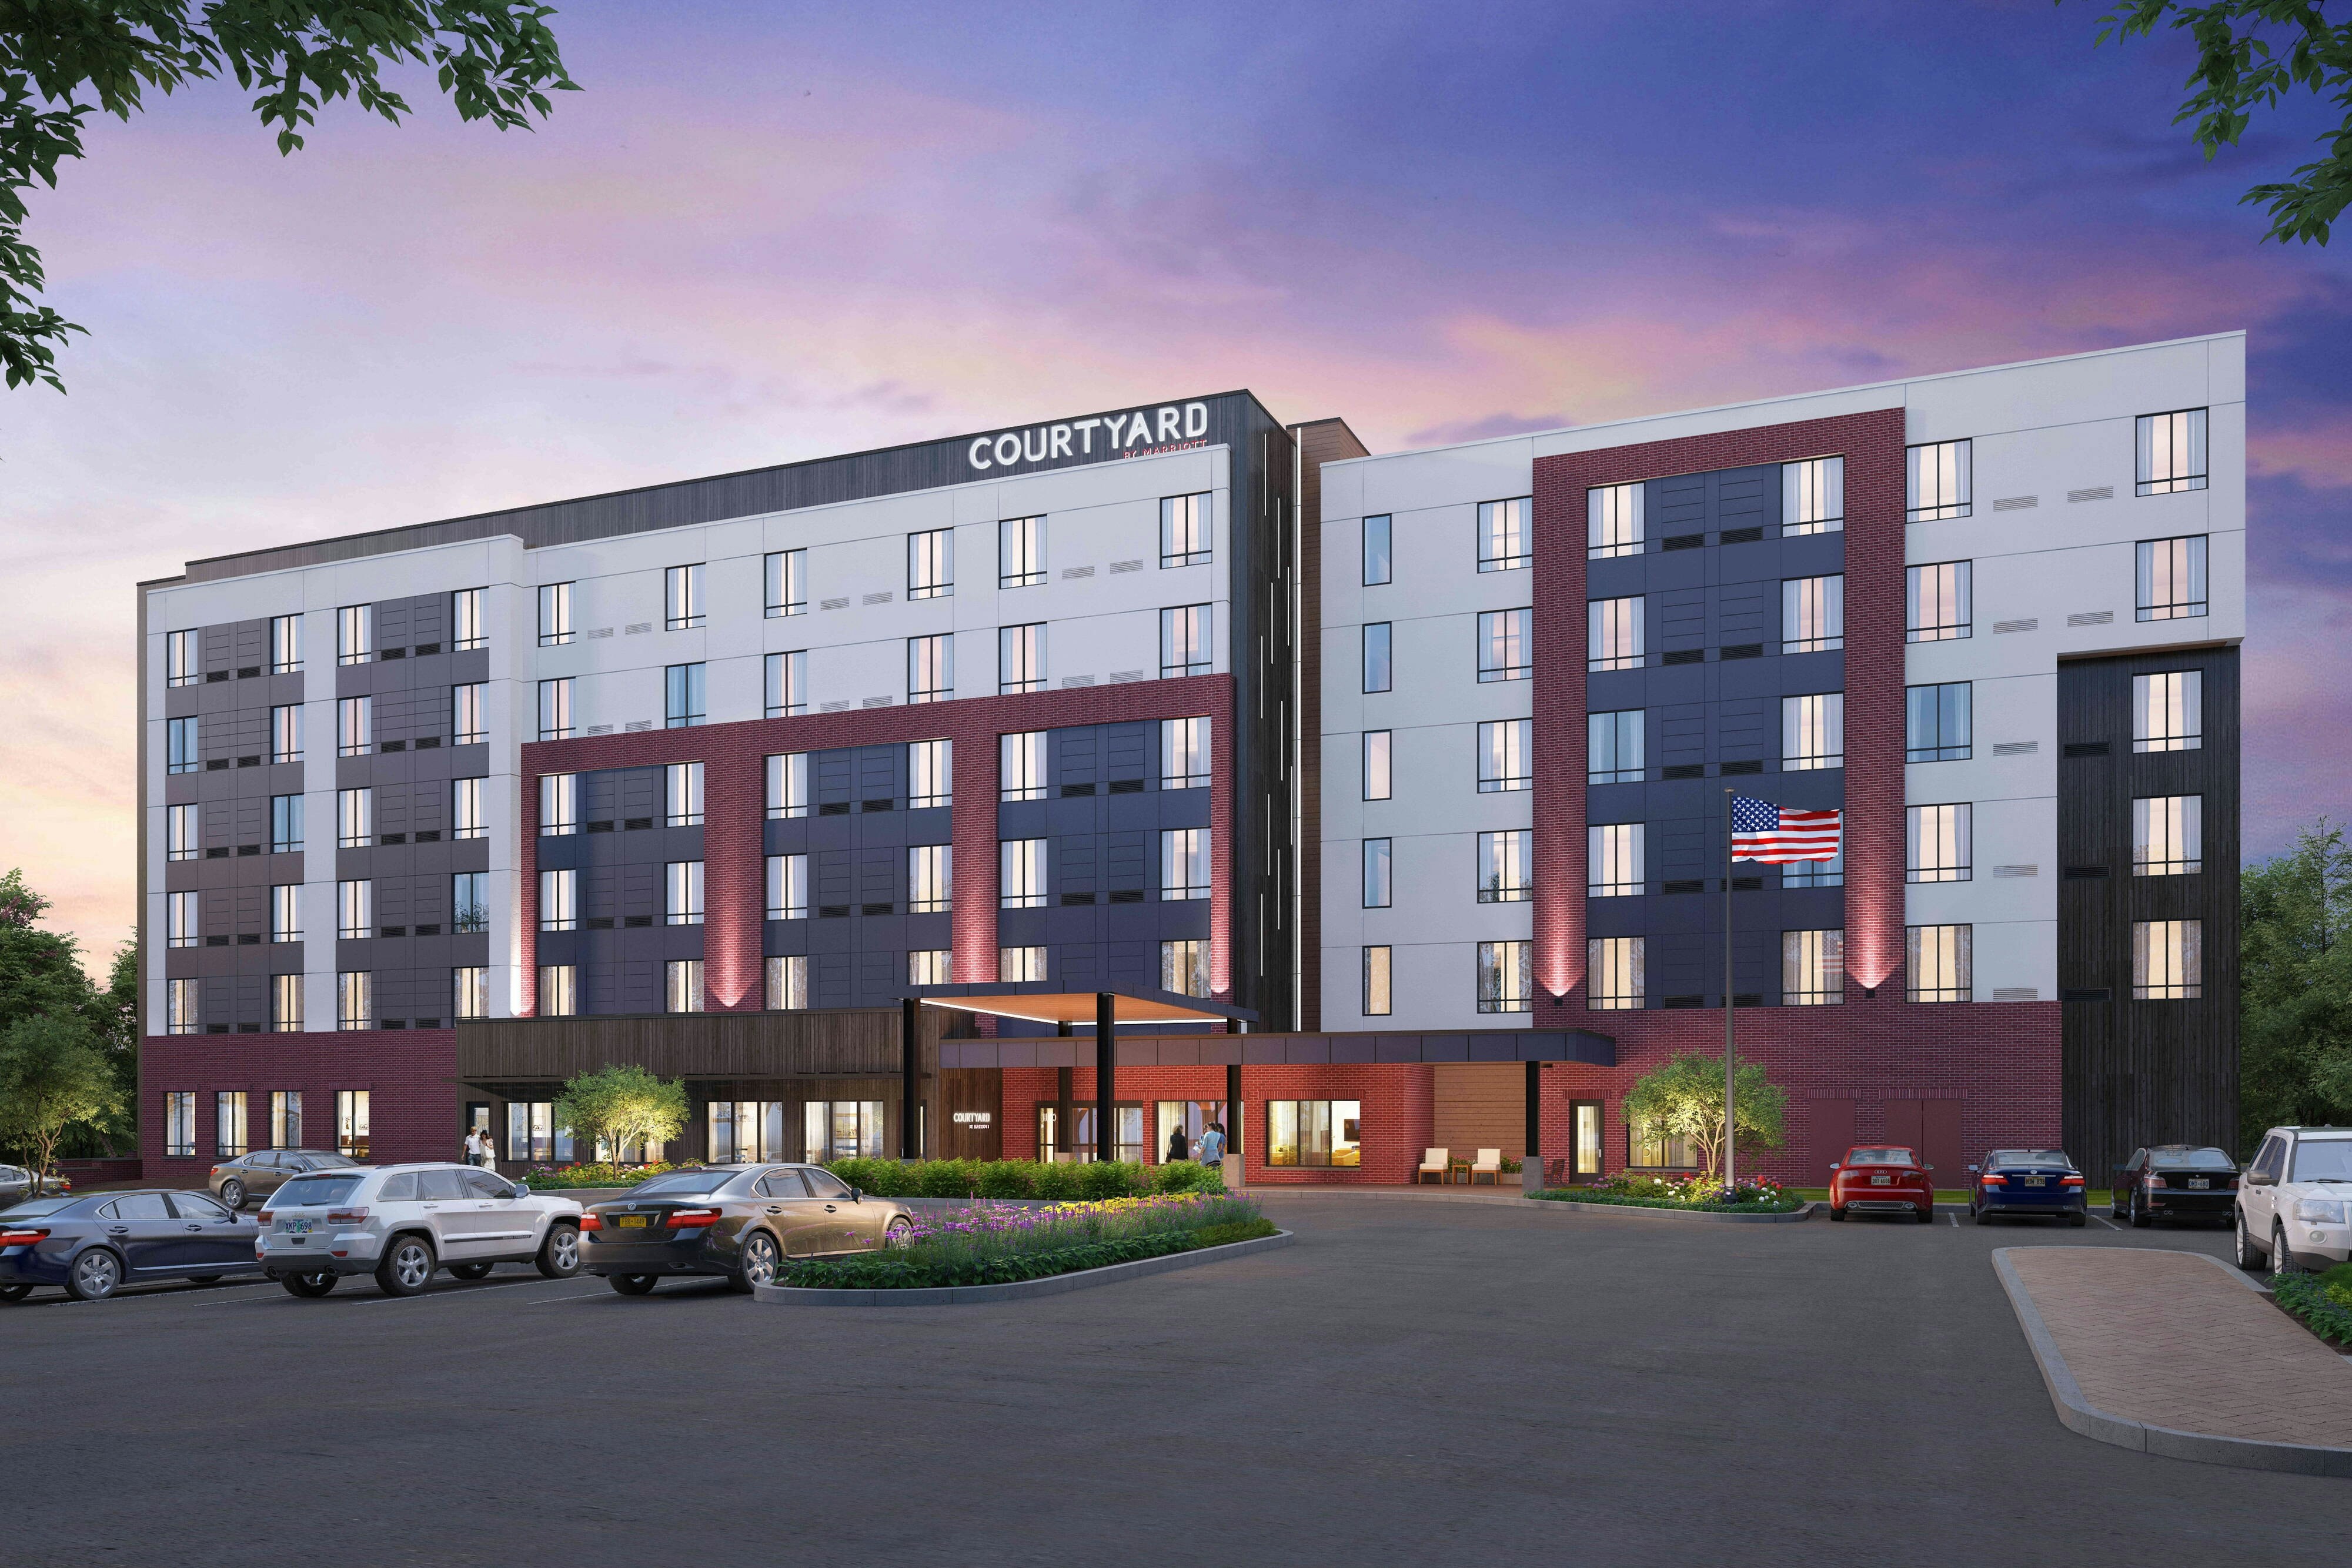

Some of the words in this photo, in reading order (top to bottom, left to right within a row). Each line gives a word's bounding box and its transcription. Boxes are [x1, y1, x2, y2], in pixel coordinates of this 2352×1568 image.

[969, 403, 1208, 470] COURTYARD
[1124, 450, 1137, 459] BY
[1142, 439, 1208, 456] MARRIOTT
[953, 1112, 990, 1122] COURTYARD
[285, 1222, 297, 1231] XKP
[300, 1222, 312, 1231] 698
